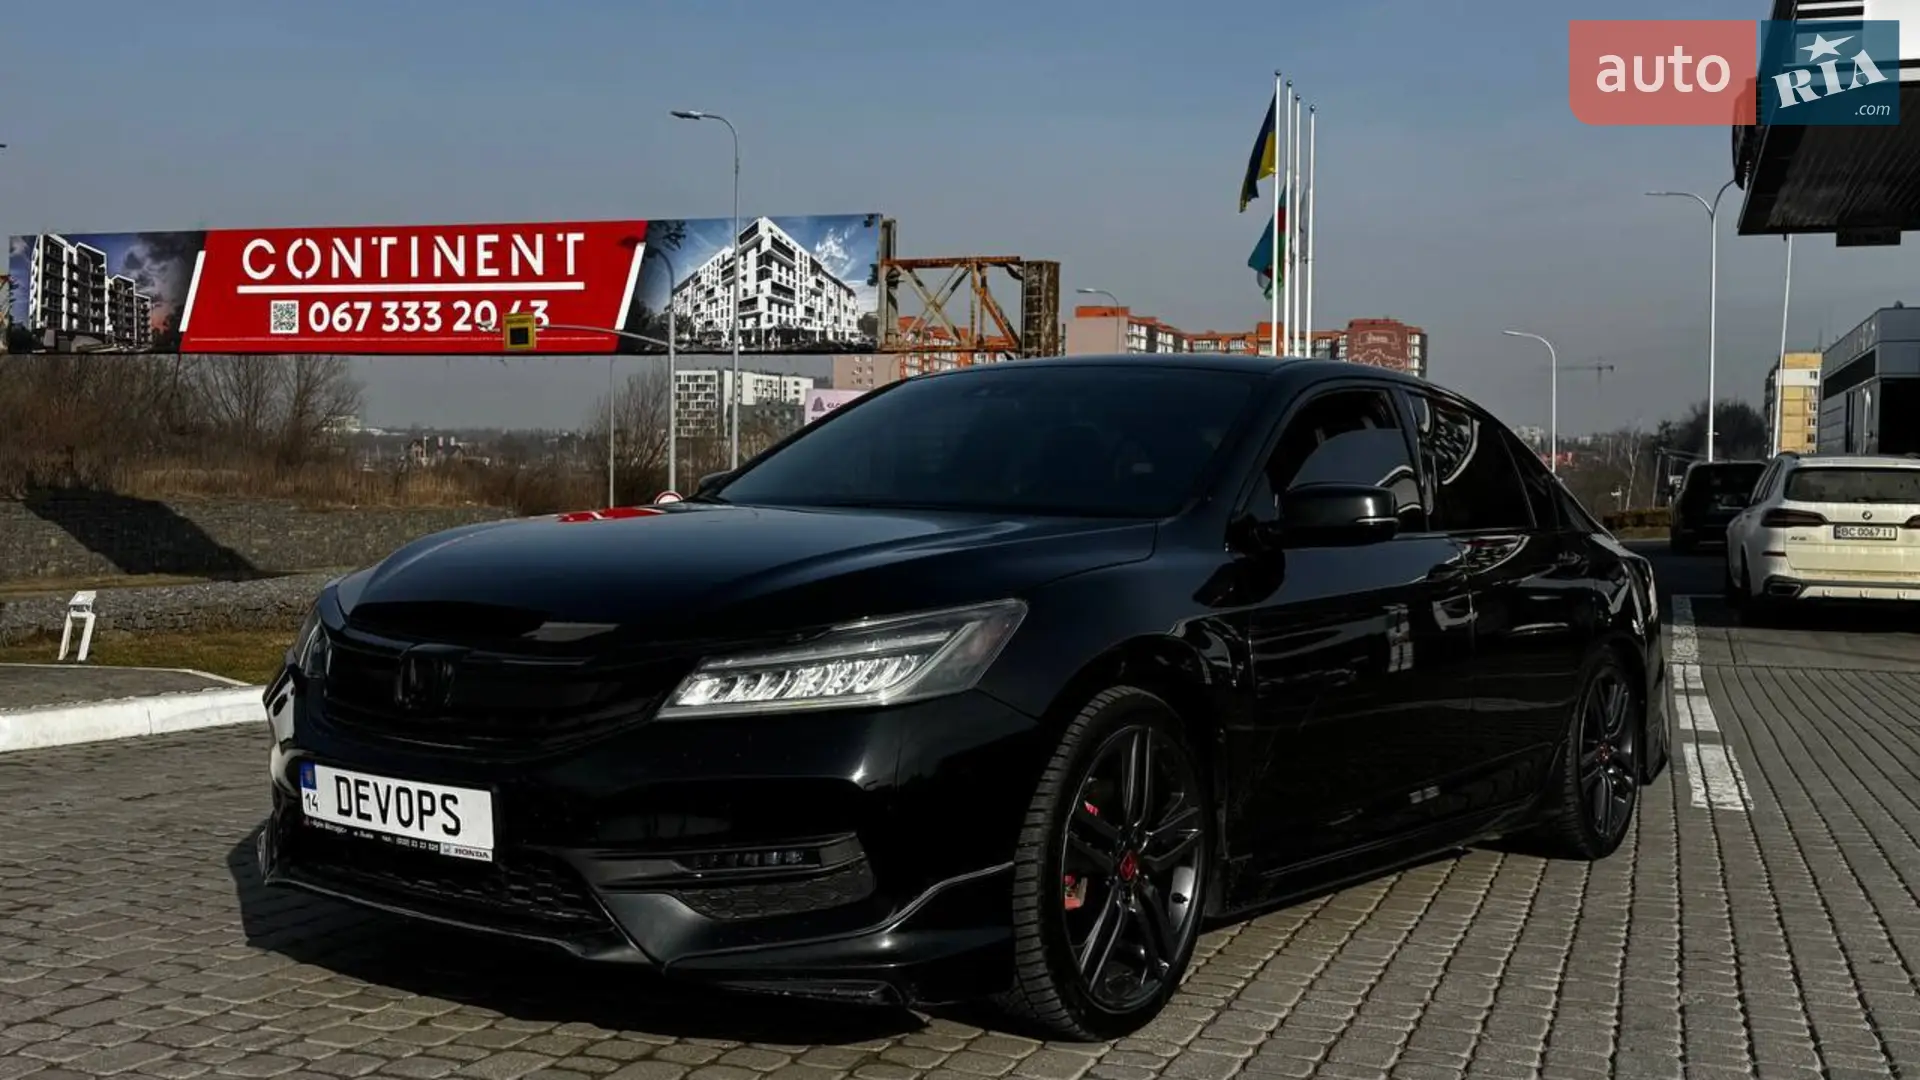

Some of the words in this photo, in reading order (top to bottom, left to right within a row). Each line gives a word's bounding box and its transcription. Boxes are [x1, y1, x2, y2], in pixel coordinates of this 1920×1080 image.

[242, 233, 585, 280] CONTINENT
[308, 300, 372, 333] 067
[381, 300, 442, 332] 333
[453, 300, 498, 332] 20
[304, 792, 319, 812] 14
[334, 775, 461, 836] DEVOPS
[454, 847, 490, 859] HONDA
